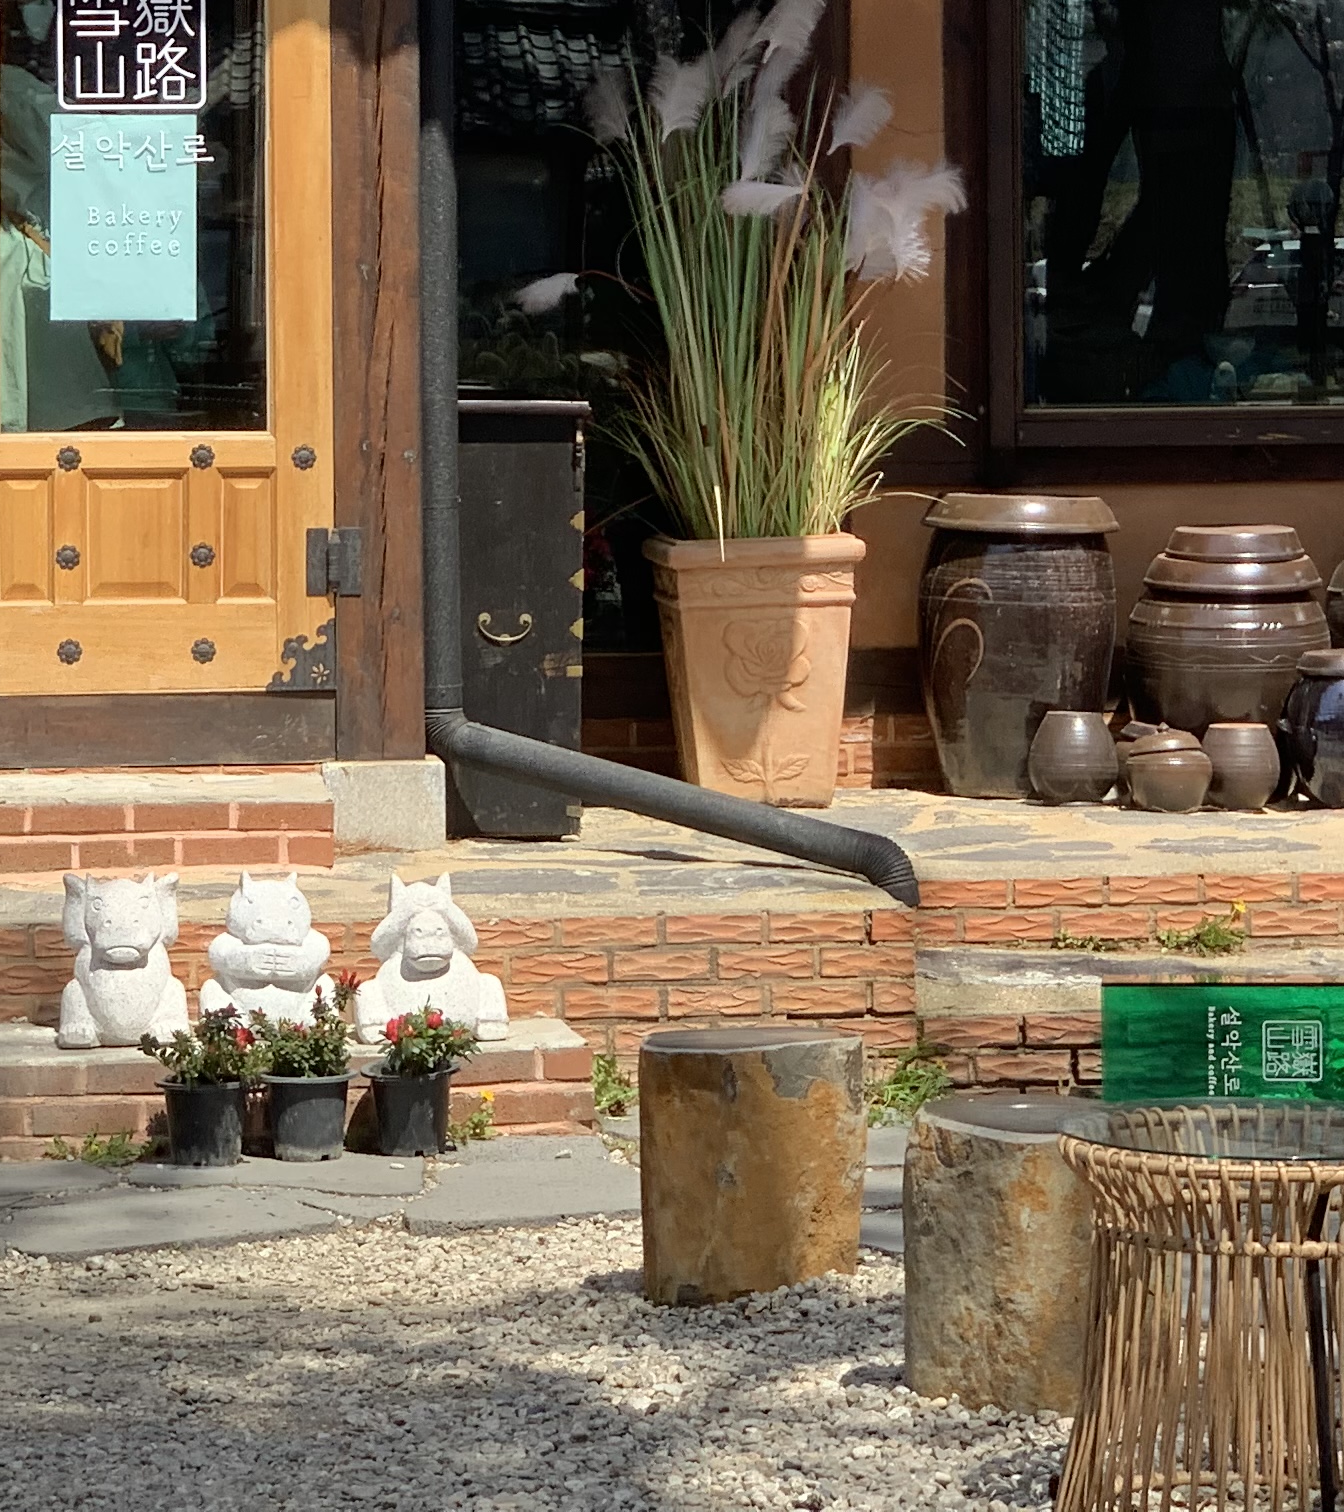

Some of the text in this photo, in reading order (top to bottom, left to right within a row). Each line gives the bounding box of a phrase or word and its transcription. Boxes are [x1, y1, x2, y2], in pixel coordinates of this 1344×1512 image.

[52, 130, 216, 171] 설악산로
[87, 206, 184, 232] Bakery
[87, 232, 182, 257] coffee
[1220, 1005, 1243, 1096] 설악산로
